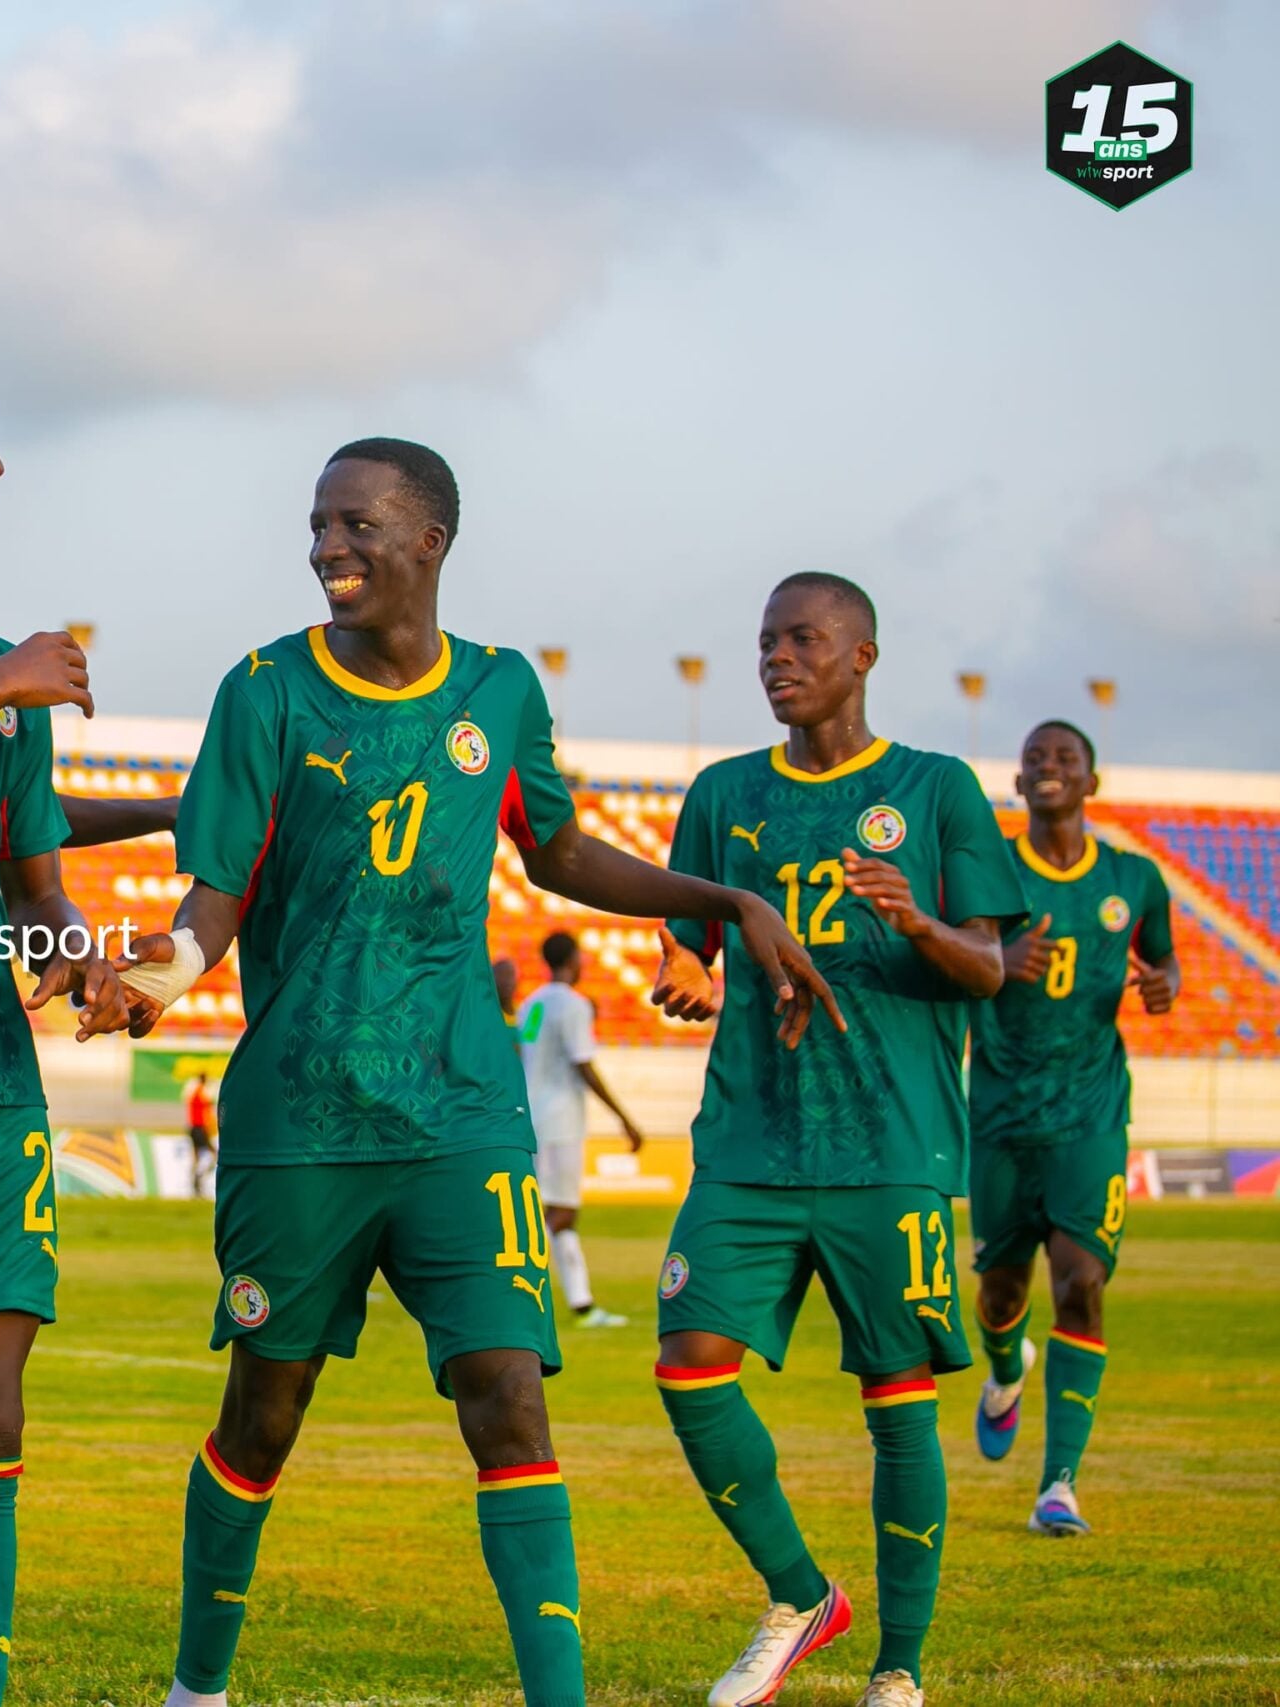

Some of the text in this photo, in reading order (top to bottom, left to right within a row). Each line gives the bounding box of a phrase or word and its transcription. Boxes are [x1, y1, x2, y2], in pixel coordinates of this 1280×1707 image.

[361, 781, 429, 876] 10
[776, 858, 845, 947] 12
[1045, 936, 1077, 1000] 8
[23, 1131, 54, 1232] 2
[484, 1172, 549, 1270] 10
[1104, 1174, 1126, 1233] 8
[896, 1211, 952, 1301] 12
